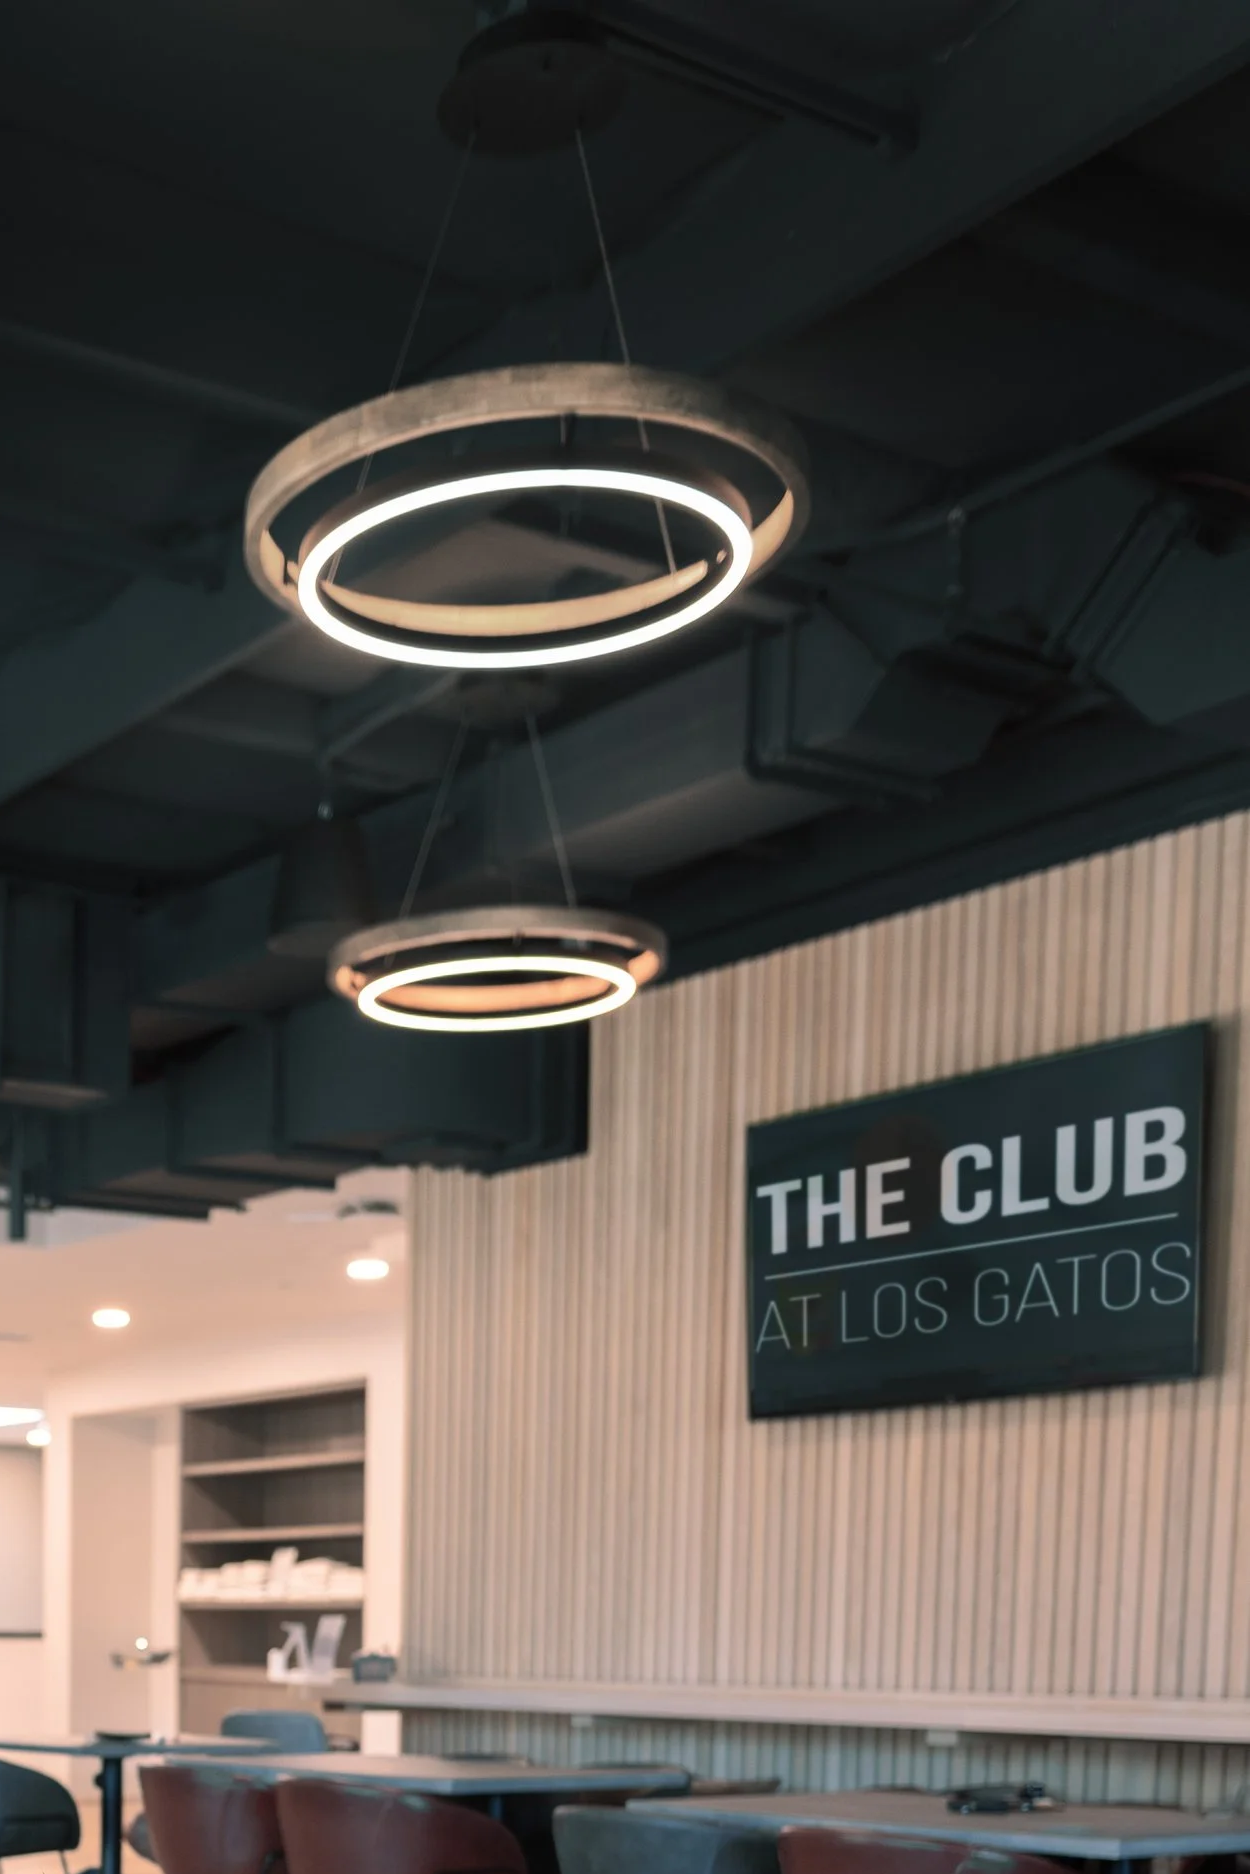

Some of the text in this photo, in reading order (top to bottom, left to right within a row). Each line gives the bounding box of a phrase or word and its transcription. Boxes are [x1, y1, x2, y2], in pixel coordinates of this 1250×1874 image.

[756, 1106, 1187, 1255] THE CLUB
[755, 1242, 1192, 1353] AT LOS GATOS
